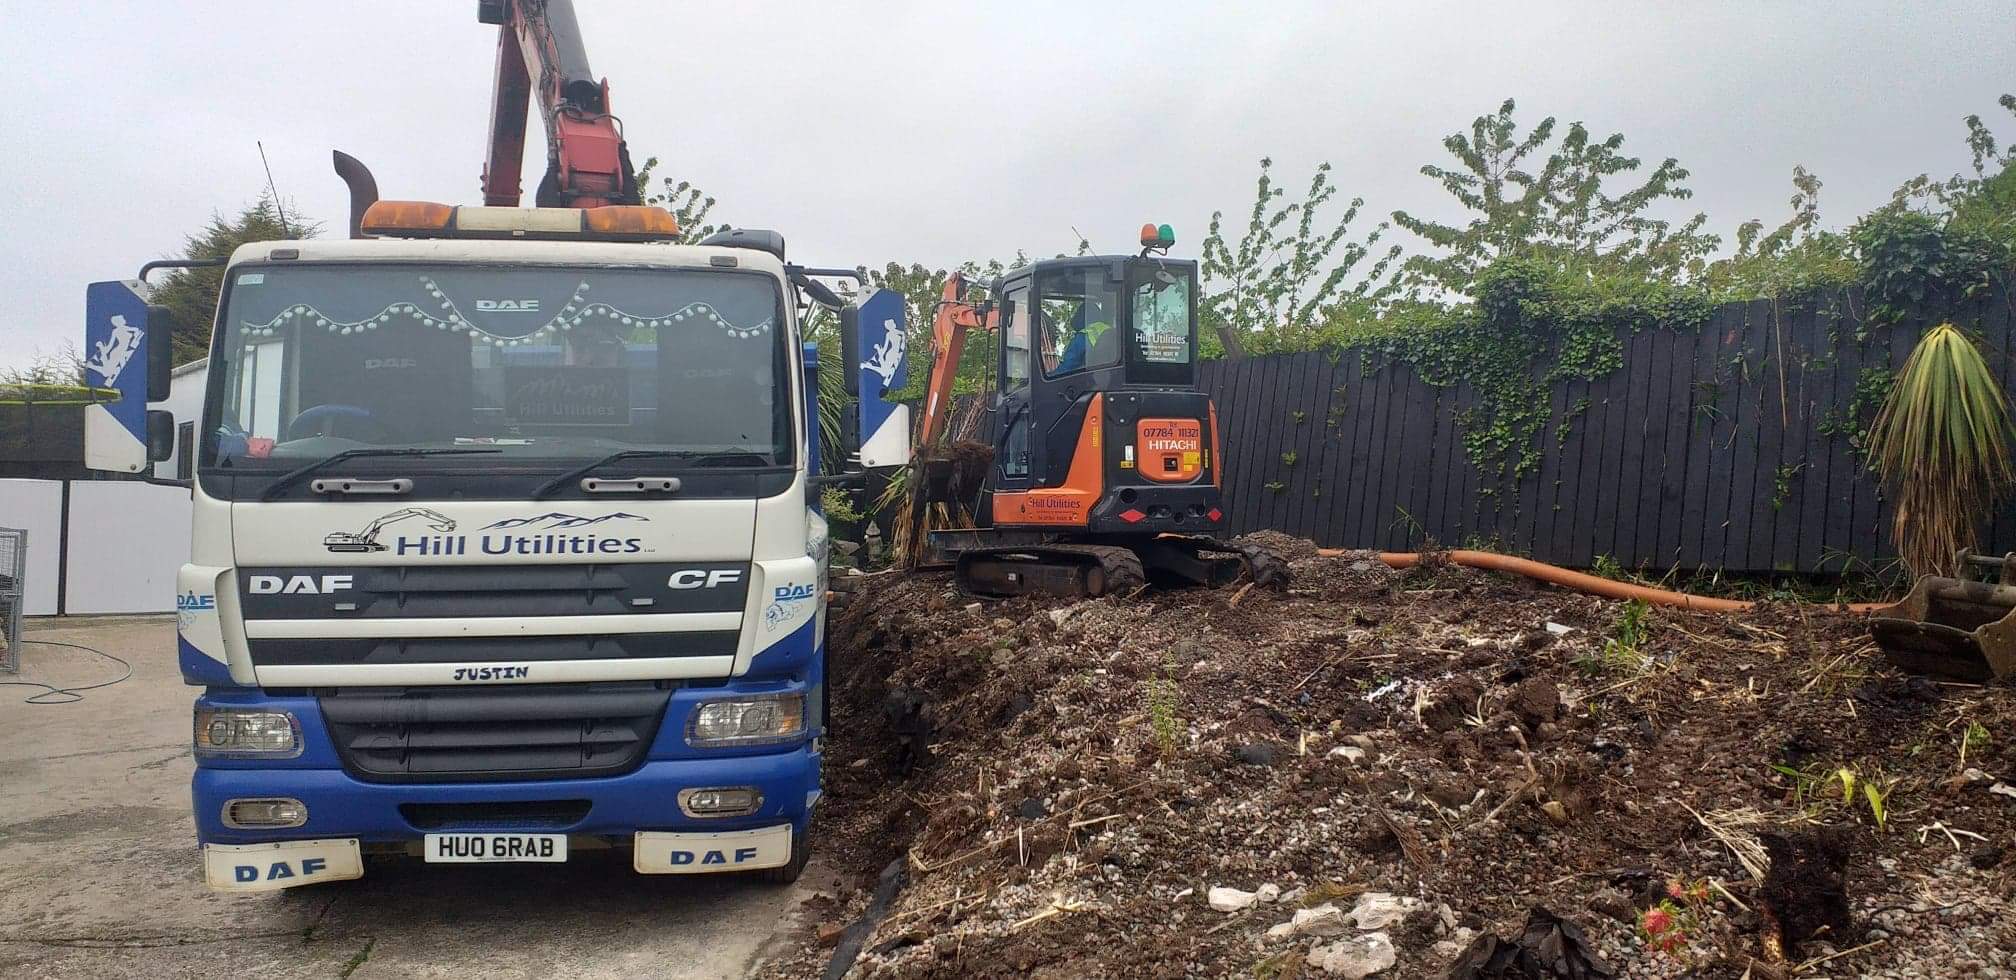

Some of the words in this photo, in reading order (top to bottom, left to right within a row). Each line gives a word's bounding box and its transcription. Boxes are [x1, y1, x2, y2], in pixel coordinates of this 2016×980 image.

[476, 300, 539, 311] DAF
[1135, 332, 1151, 343] Hill
[1152, 333, 1186, 345] Utilities
[1144, 428, 1173, 438] 07784
[1149, 440, 1197, 450] HITACHI
[1046, 499, 1081, 509] Utilities
[397, 536, 465, 556] Hill
[481, 535, 642, 555] Utilities
[249, 576, 353, 594] DAF
[668, 570, 742, 589] CF
[775, 584, 814, 600] DAF
[177, 594, 215, 609] DAF
[454, 666, 529, 681] JUSTIN
[492, 836, 554, 857] 6RAB
[670, 848, 758, 865] DAF
[235, 858, 327, 882] DAF
